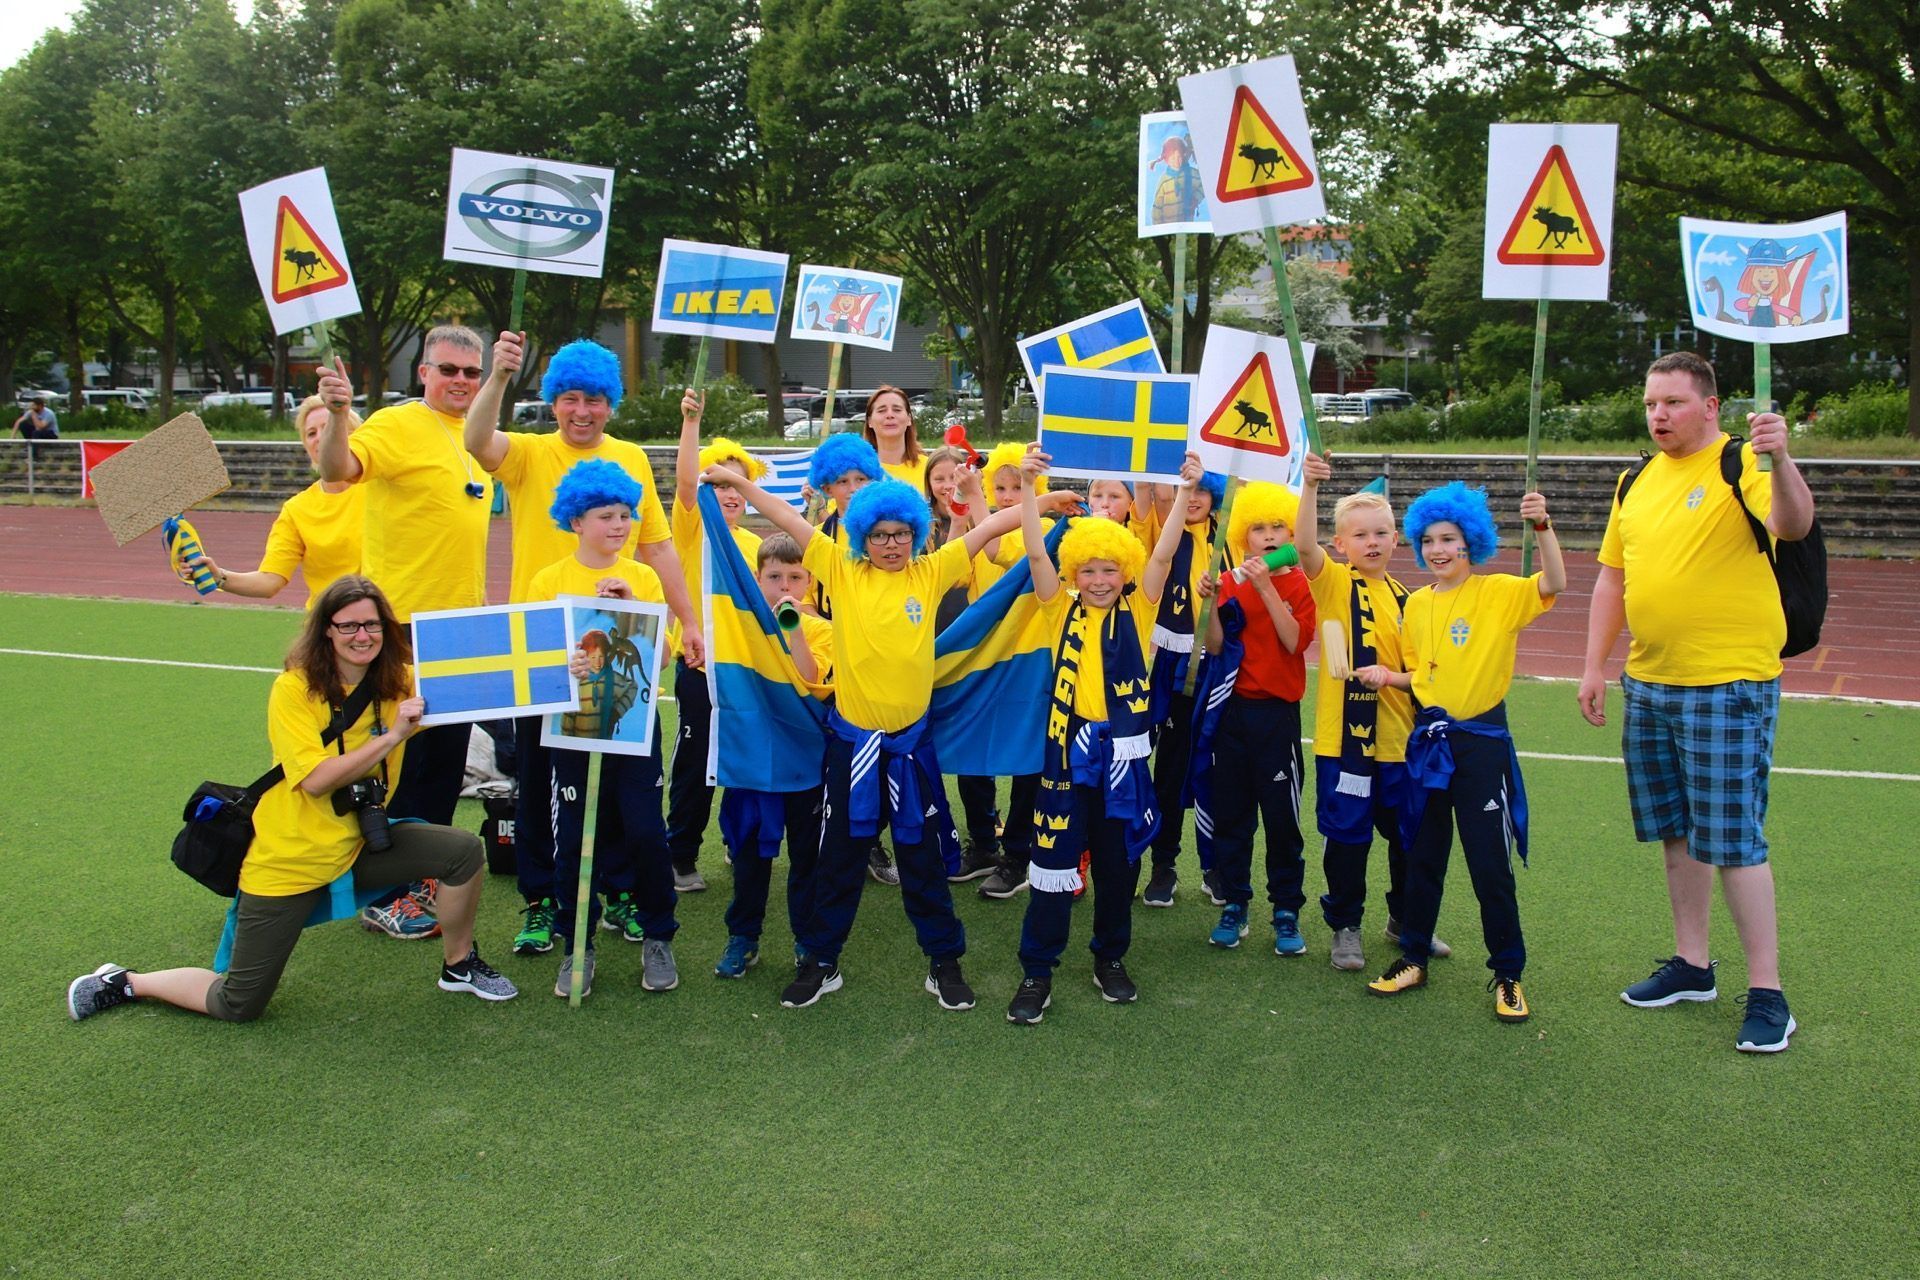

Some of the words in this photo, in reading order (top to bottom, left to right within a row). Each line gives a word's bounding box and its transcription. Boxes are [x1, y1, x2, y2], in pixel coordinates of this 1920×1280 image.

[470, 200, 591, 226] VOLVO
[672, 289, 776, 315] IKEA
[1166, 716, 1174, 729] 4
[684, 725, 692, 739] 2
[560, 785, 578, 802] 10
[826, 804, 832, 819] 9
[498, 819, 516, 837] DE
